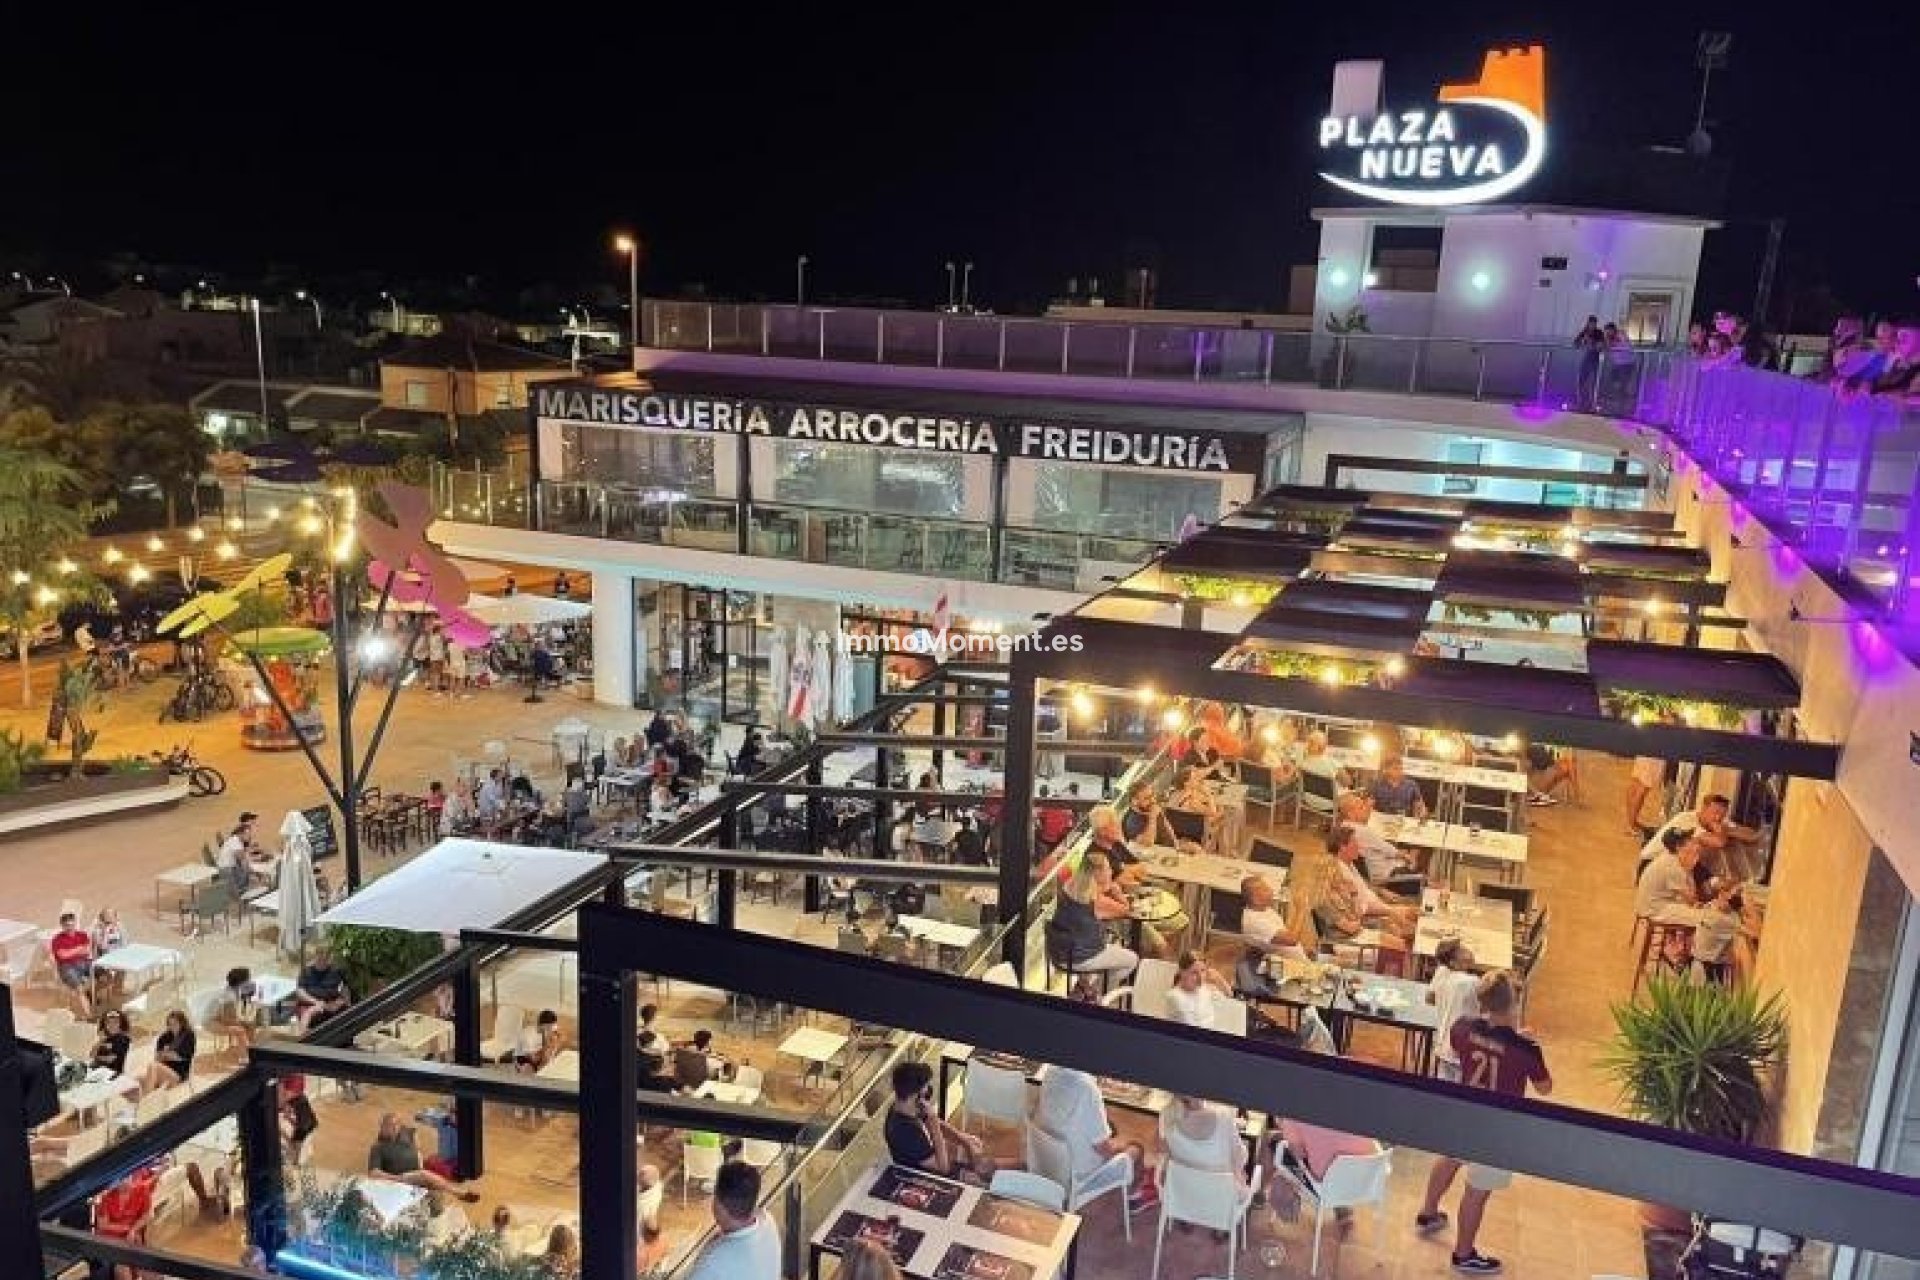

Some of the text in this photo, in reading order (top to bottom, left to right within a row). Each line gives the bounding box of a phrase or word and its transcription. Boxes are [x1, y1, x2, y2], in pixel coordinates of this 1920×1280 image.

[1320, 109, 1455, 147] PLAZA
[1361, 144, 1503, 178] NUEVA
[1470, 1050, 1498, 1090] 21
